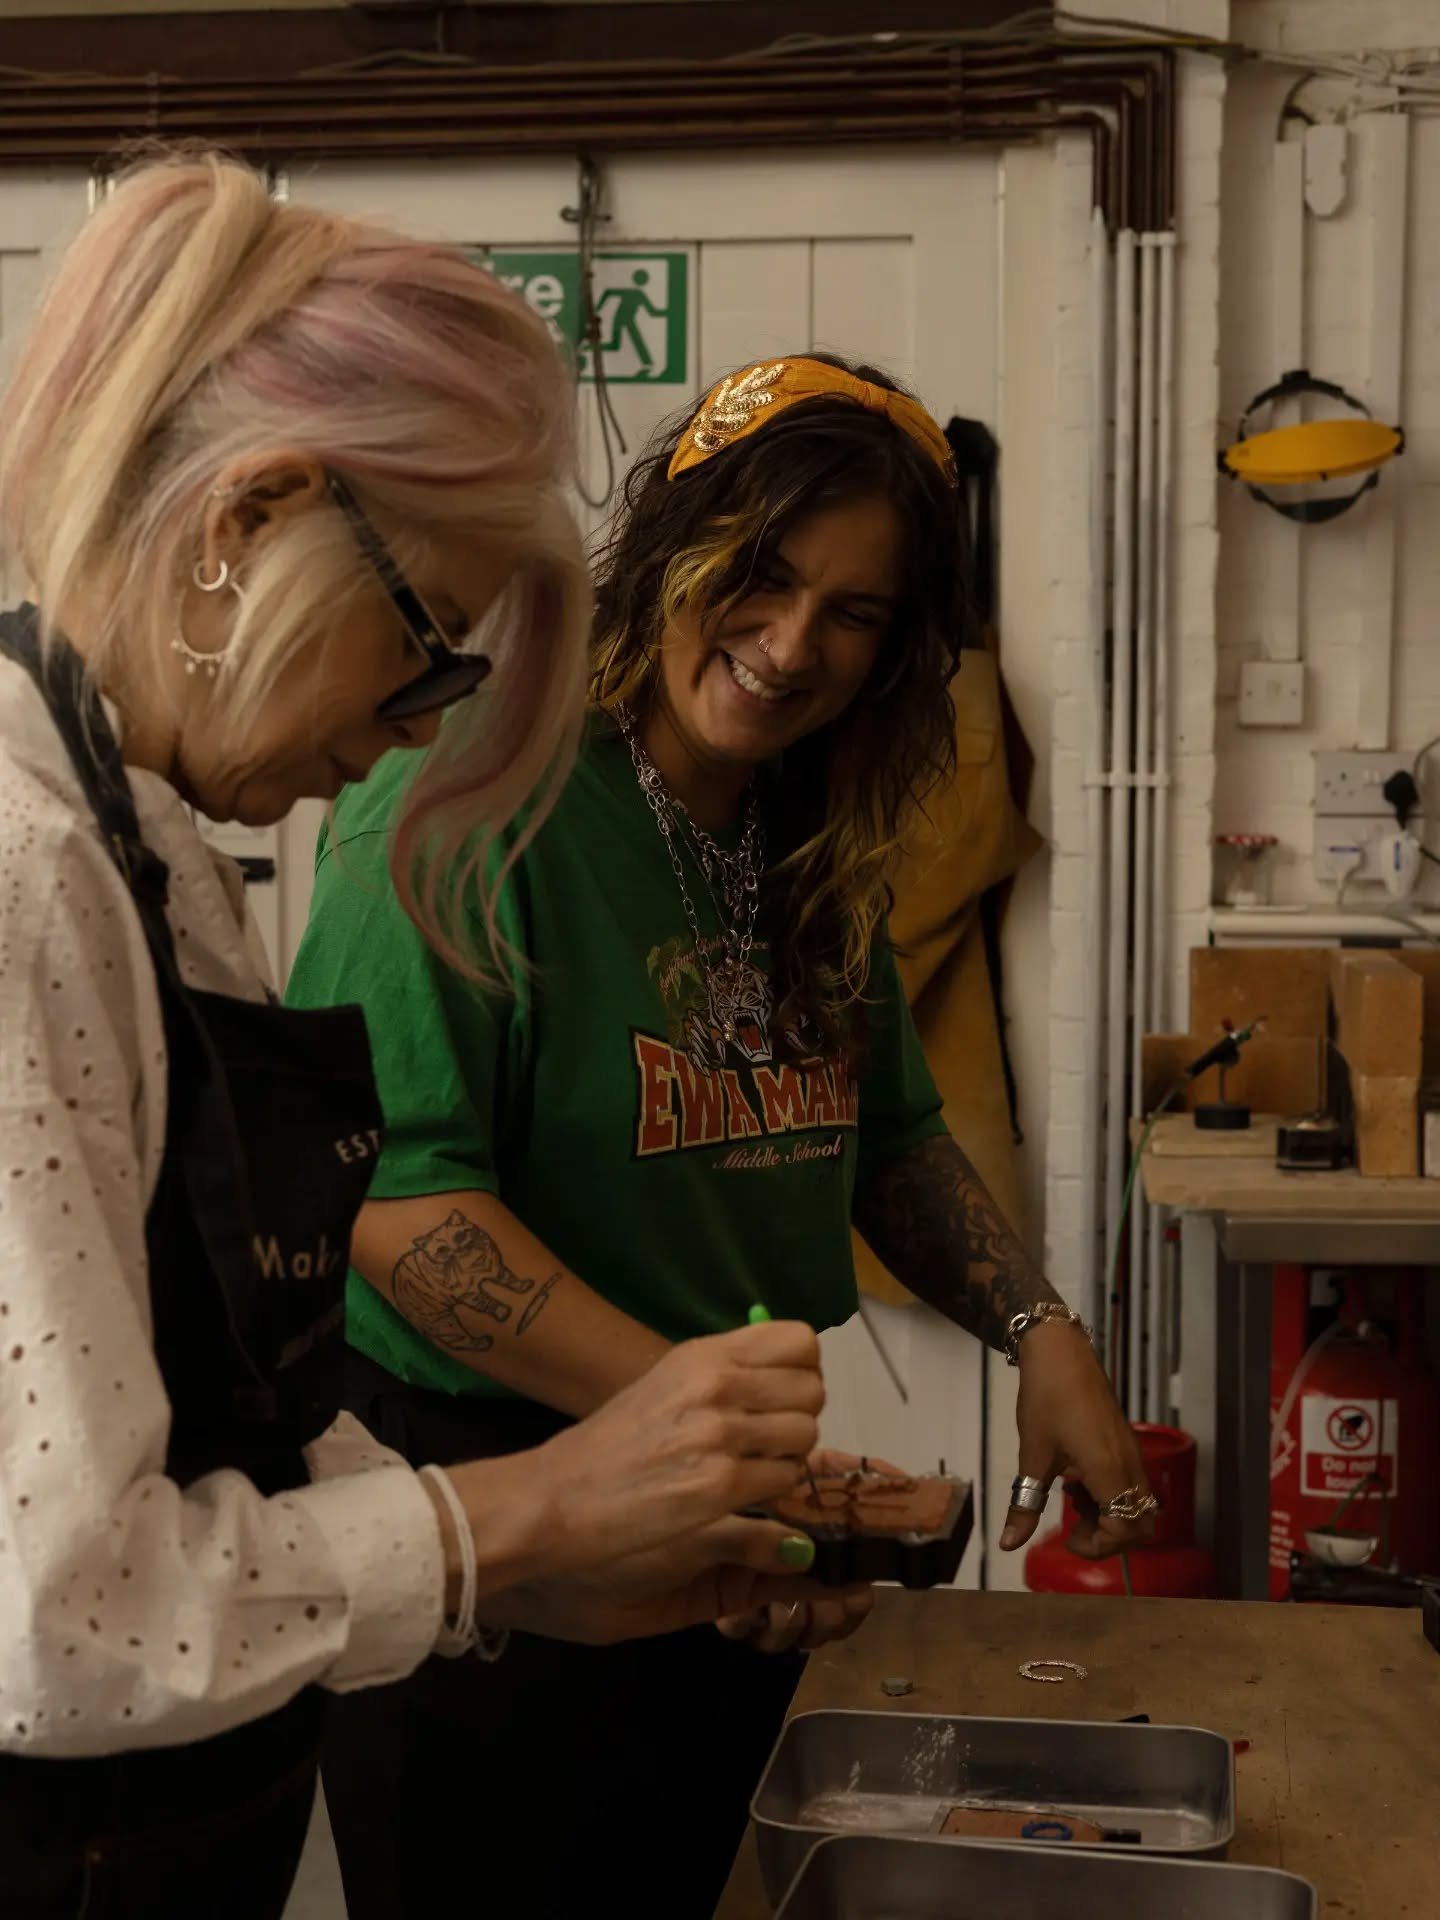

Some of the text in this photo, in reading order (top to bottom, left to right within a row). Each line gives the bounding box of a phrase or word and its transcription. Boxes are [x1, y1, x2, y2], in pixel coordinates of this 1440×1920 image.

[712, 1135, 842, 1169] Middle School
[252, 1233, 342, 1280] Mak
[1321, 1456, 1346, 1473] Do
